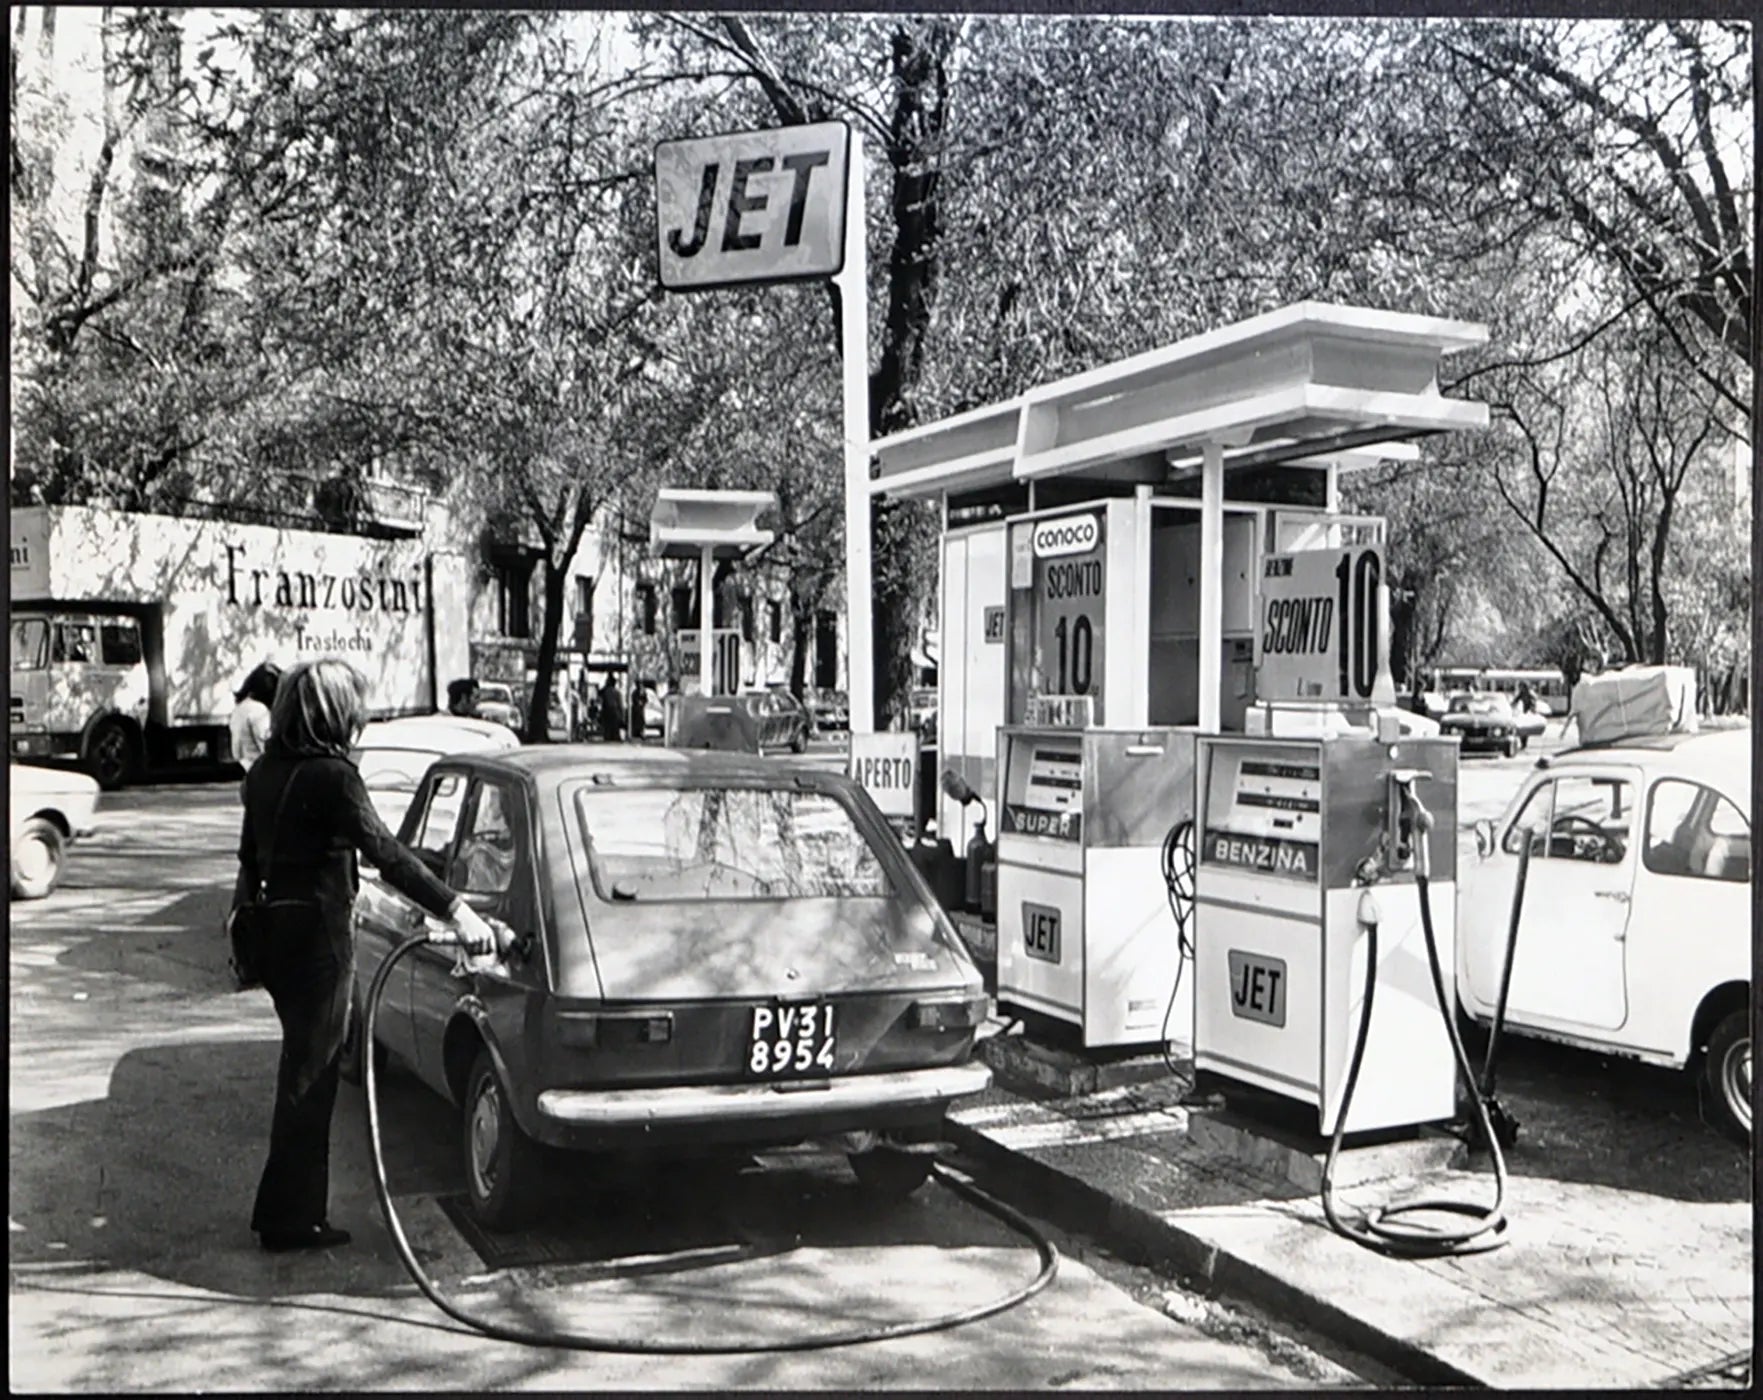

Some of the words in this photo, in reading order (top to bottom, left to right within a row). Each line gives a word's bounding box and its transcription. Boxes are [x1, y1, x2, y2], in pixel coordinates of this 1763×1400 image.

[667, 151, 830, 257] JET
[226, 544, 423, 612] Franzosini
[1047, 560, 1101, 599] SCONTO
[295, 624, 372, 651] Traslochi
[1263, 597, 1333, 654] SCONTO
[1336, 549, 1380, 698] 10
[718, 634, 739, 694] 10
[1055, 614, 1092, 695] 10
[855, 757, 911, 790] APERTO
[1015, 813, 1071, 834] SUPER
[1215, 839, 1307, 872] BENZINA
[1025, 914, 1057, 954] JET
[1235, 965, 1281, 1014] JET
[750, 1037, 834, 1073] 8954
